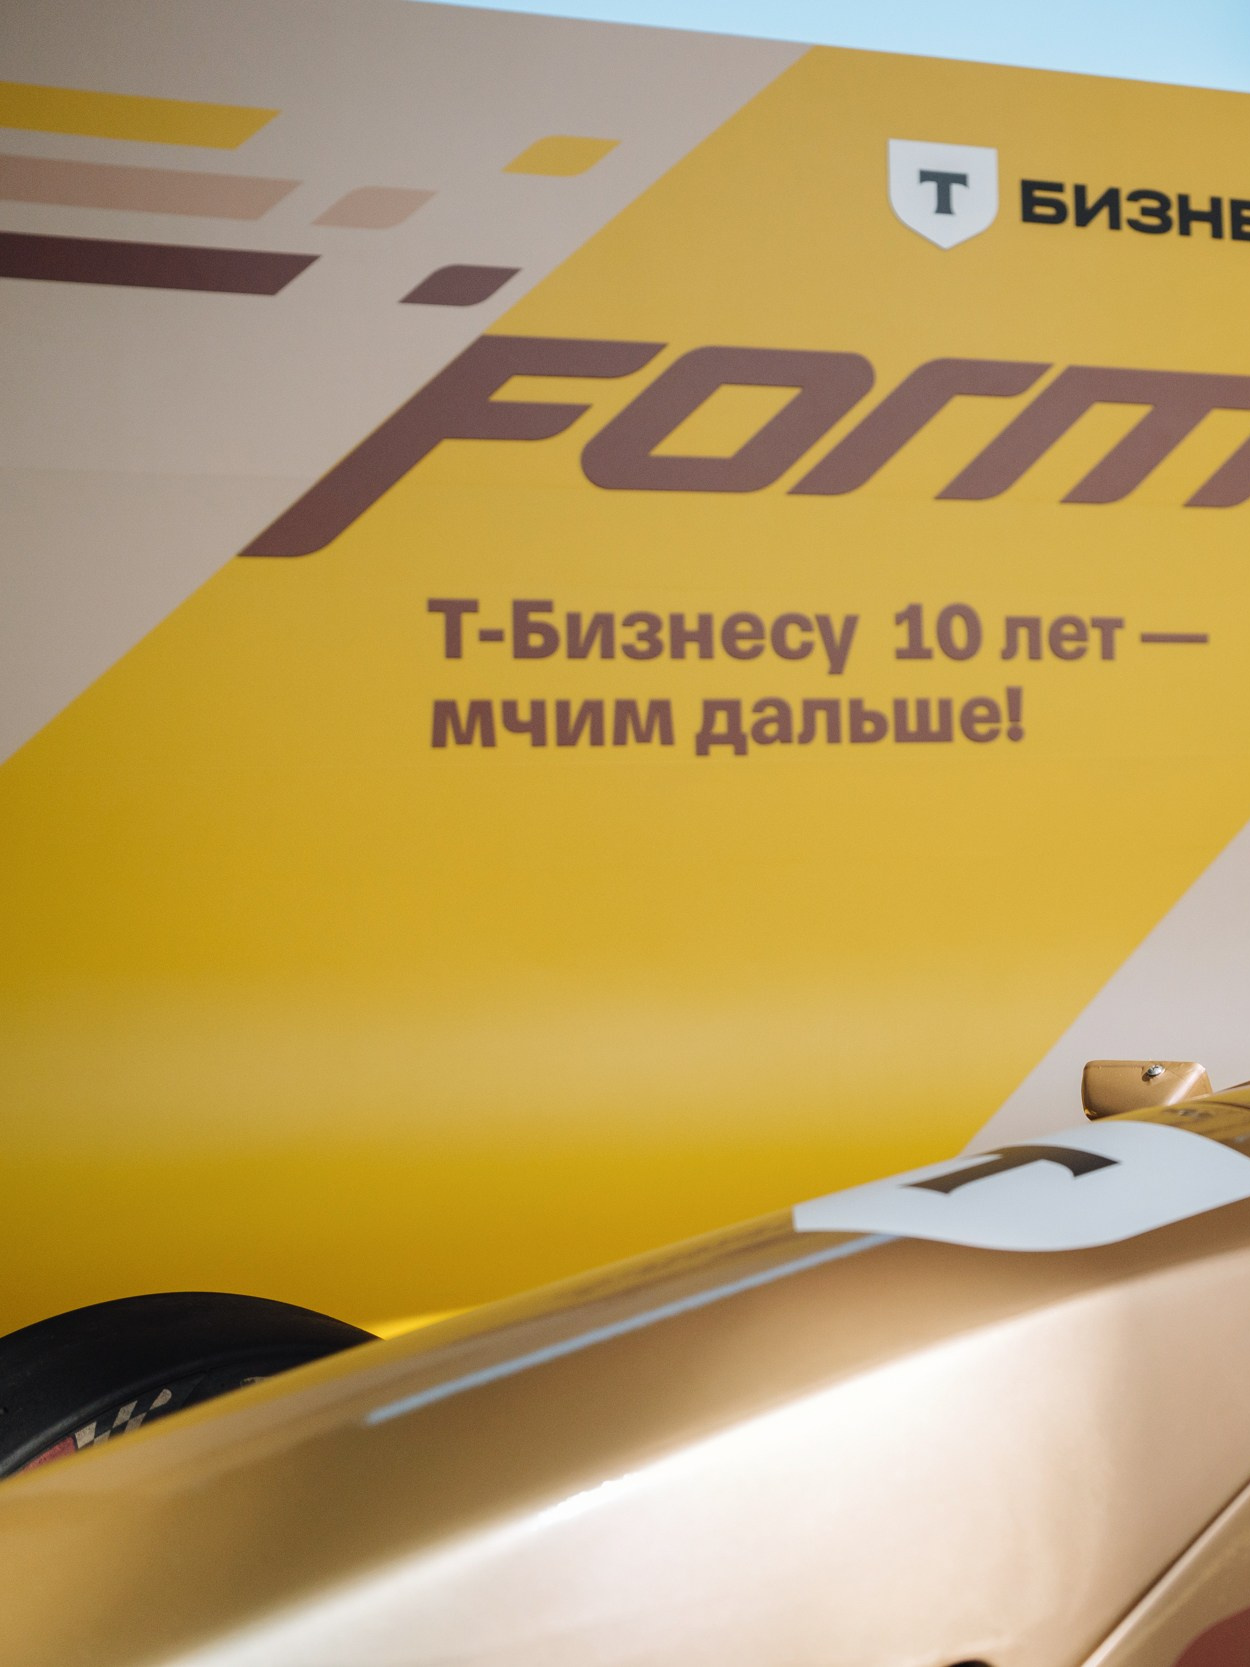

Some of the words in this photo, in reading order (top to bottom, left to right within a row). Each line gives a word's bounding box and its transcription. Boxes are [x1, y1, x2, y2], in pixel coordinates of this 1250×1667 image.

[918, 168, 969, 216] Т
[427, 598, 859, 675] Т-Бизнесу
[893, 603, 983, 661] 10
[1000, 613, 1126, 661] лет
[430, 698, 675, 748] мчим
[694, 686, 1025, 757] дальше!
